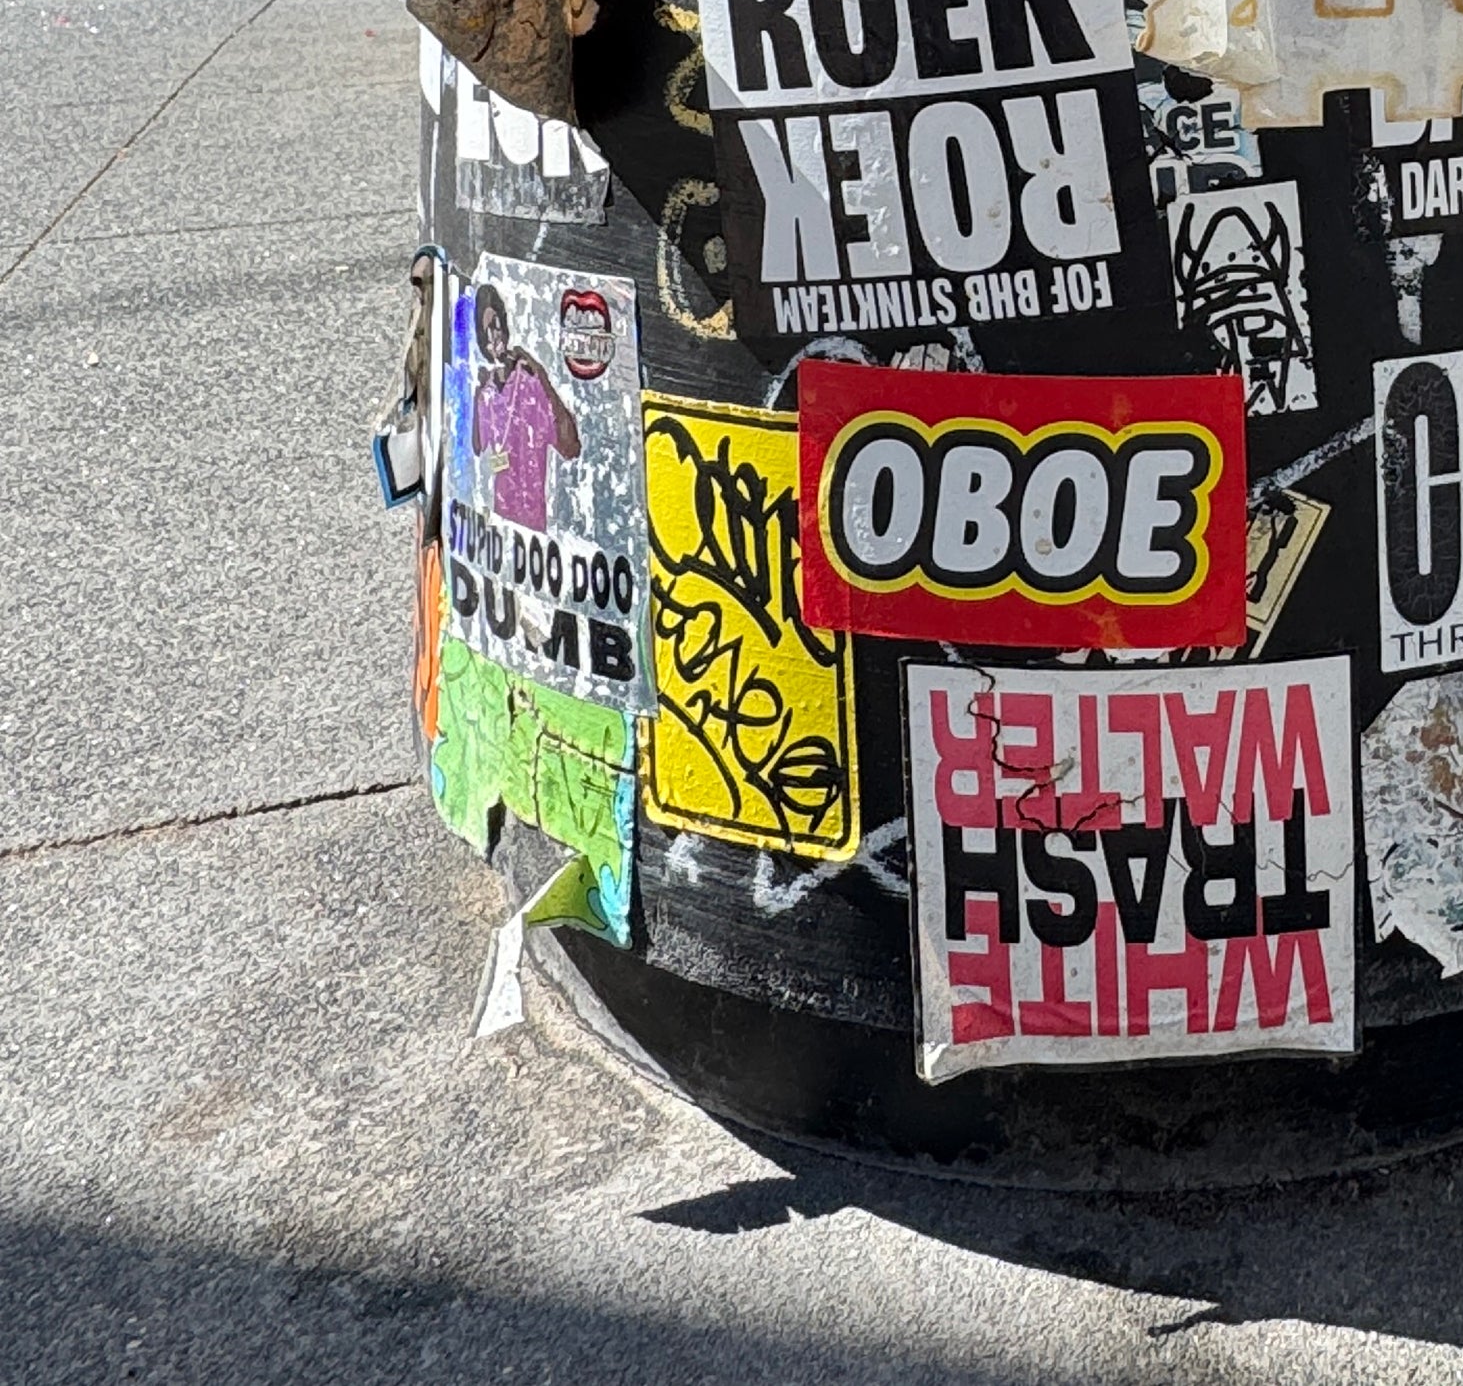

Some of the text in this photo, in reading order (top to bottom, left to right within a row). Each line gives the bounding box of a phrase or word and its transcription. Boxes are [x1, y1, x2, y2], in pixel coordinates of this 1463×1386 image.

[737, 88, 1122, 283] ROEK
[772, 261, 1114, 335] FOF BHB STINKTEAM
[450, 498, 633, 614] STUPID DOO DOO
[842, 437, 1195, 579] OBOE
[450, 558, 636, 682] DUMB
[930, 684, 1331, 830] WALTER
[943, 788, 1331, 947] TRASH
[948, 892, 1334, 1046] WHITE
